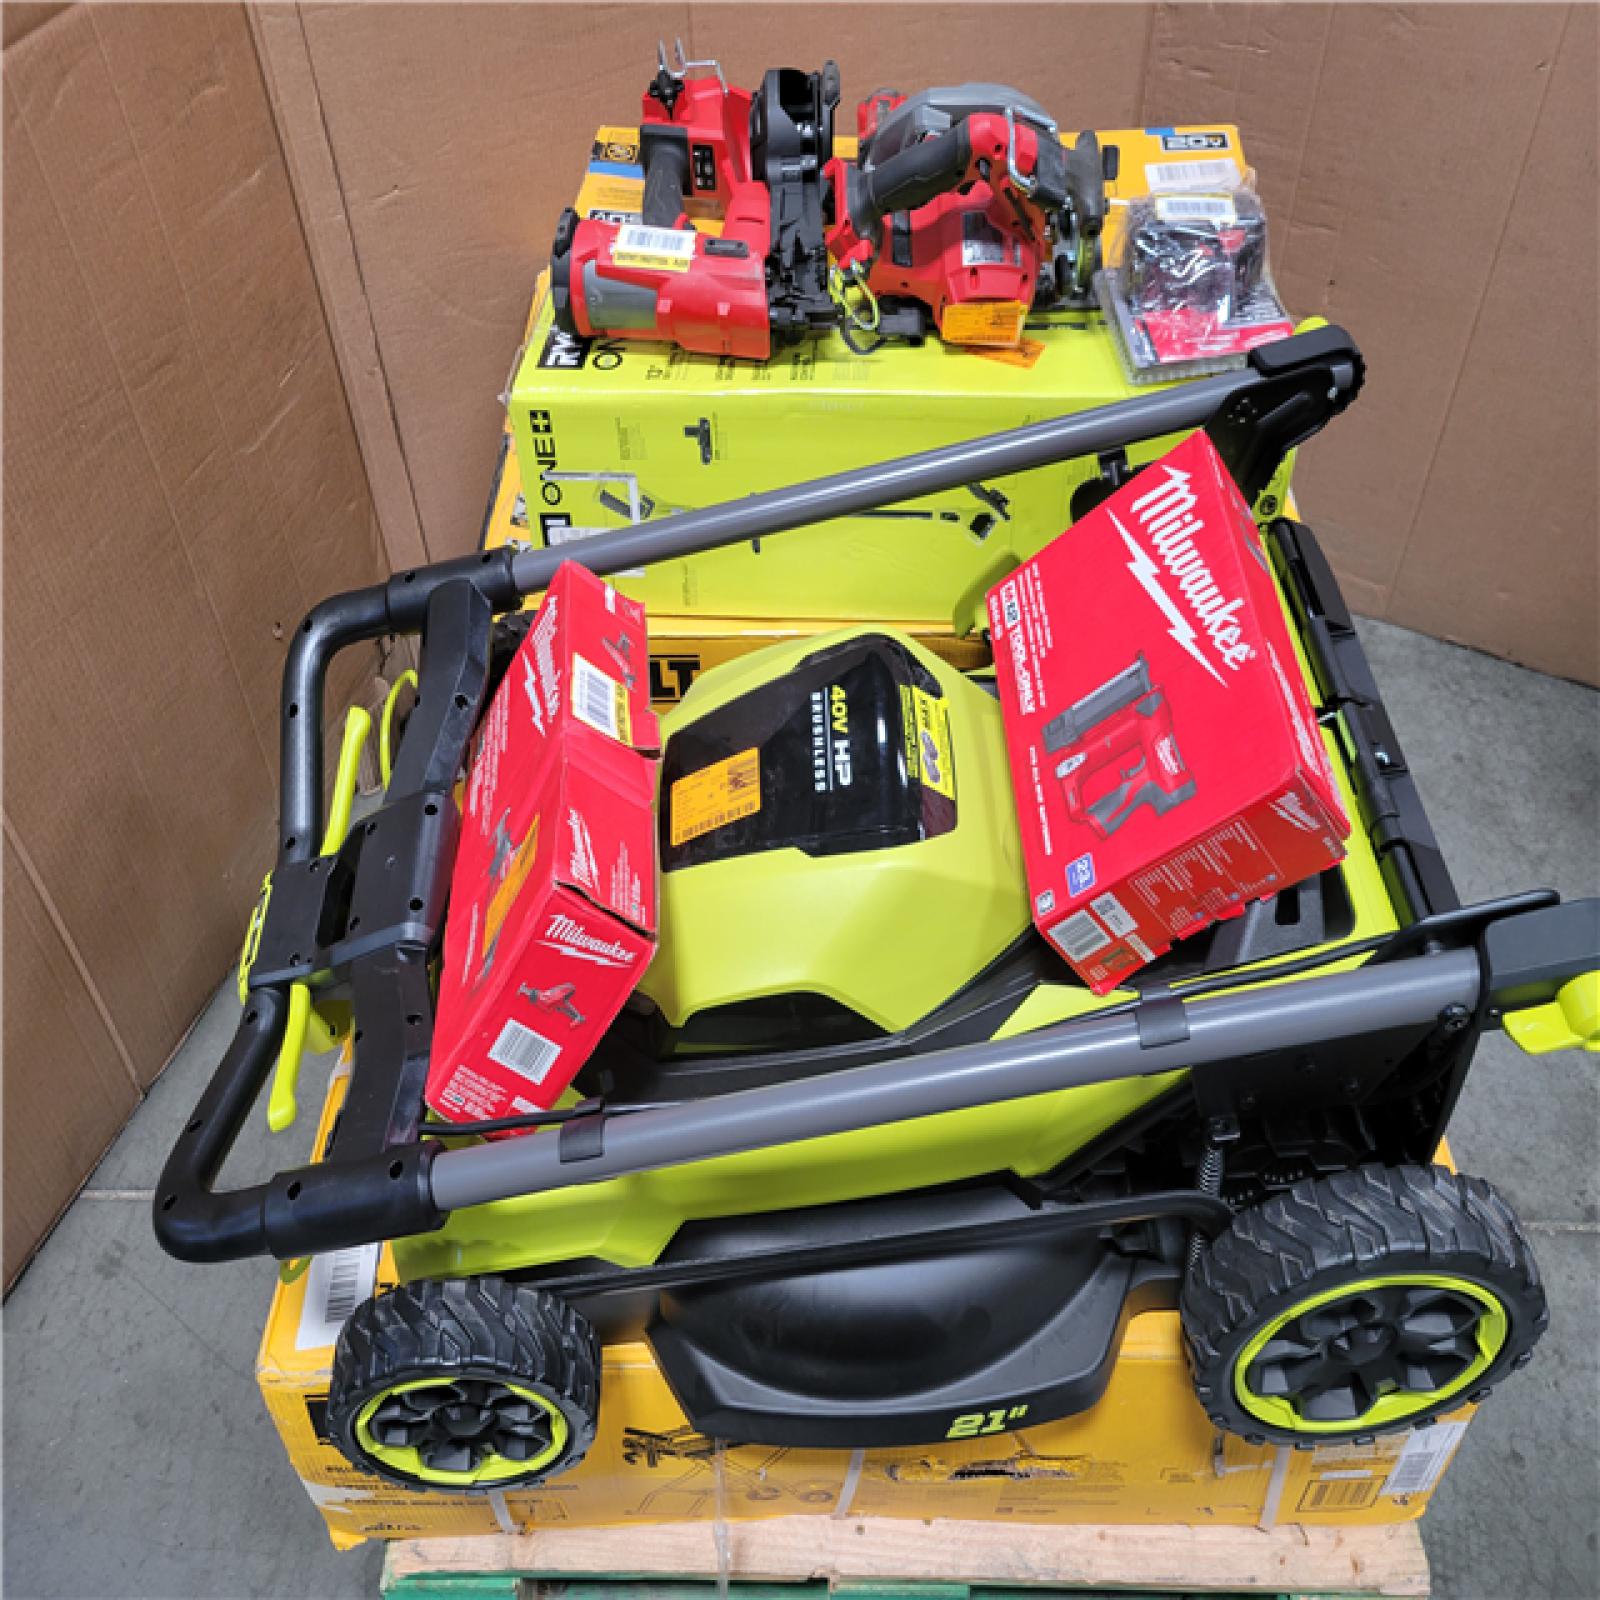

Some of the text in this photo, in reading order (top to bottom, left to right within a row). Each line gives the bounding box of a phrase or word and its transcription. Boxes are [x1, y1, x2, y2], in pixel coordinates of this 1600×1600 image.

[1130, 465, 1257, 671] Milwaukee
[831, 685, 852, 786] 40V HP
[545, 912, 638, 962] Milwaukee
[945, 1405, 1028, 1438] 21"
